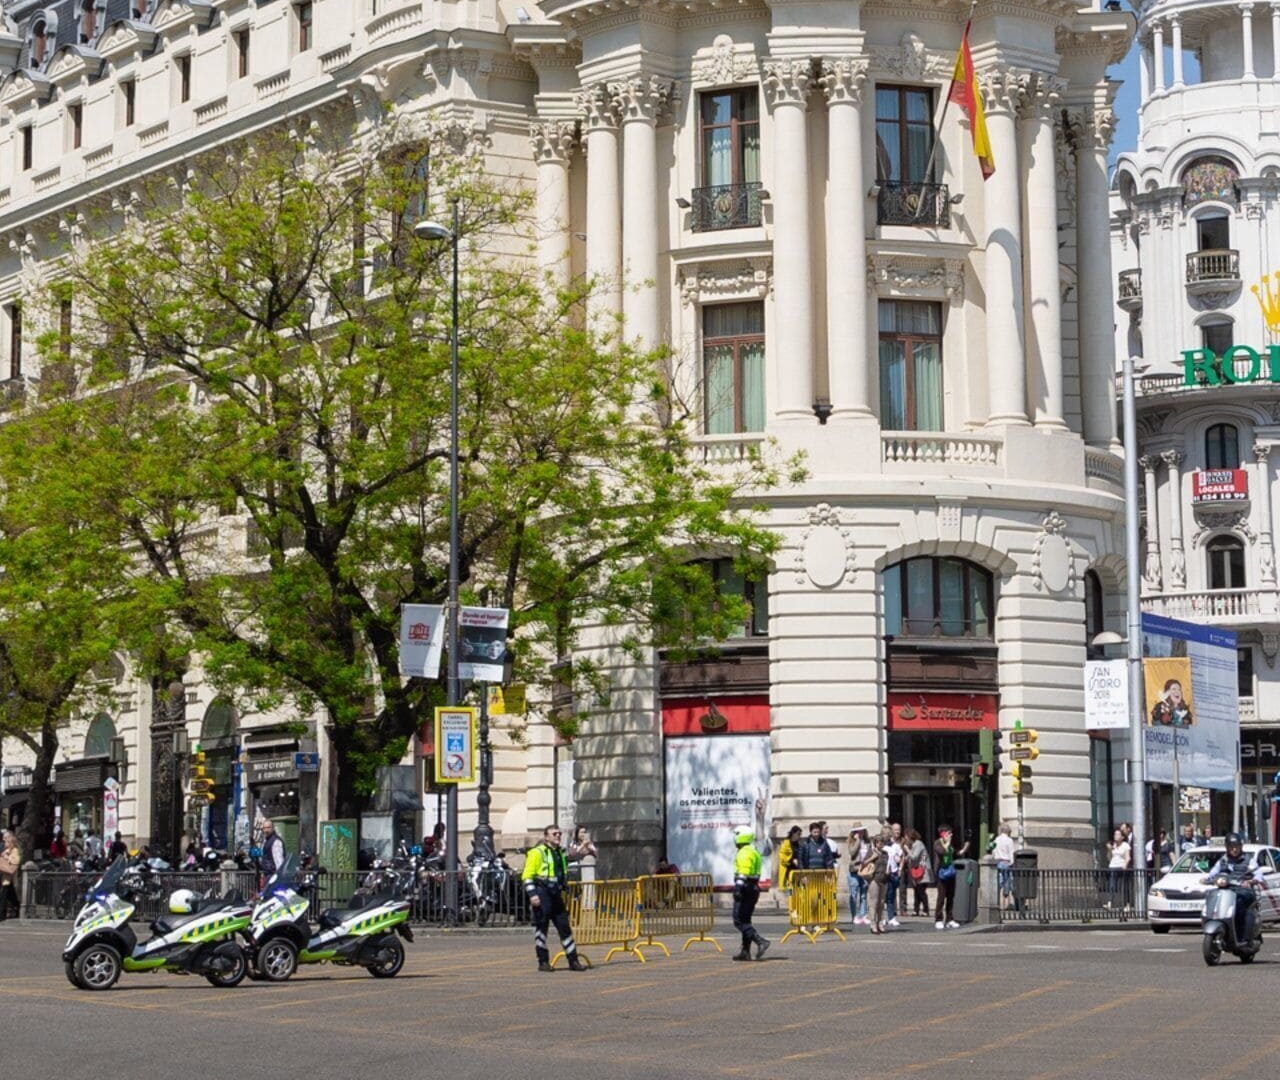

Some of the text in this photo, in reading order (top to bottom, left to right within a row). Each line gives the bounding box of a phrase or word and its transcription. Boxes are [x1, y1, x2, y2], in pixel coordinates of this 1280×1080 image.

[1198, 484, 1235, 494] LOCALES
[1090, 667, 1110, 680] SAN
[920, 703, 984, 721] Santander
[691, 787, 738, 797] Valientes,
[690, 796, 752, 806] necesitamos.
